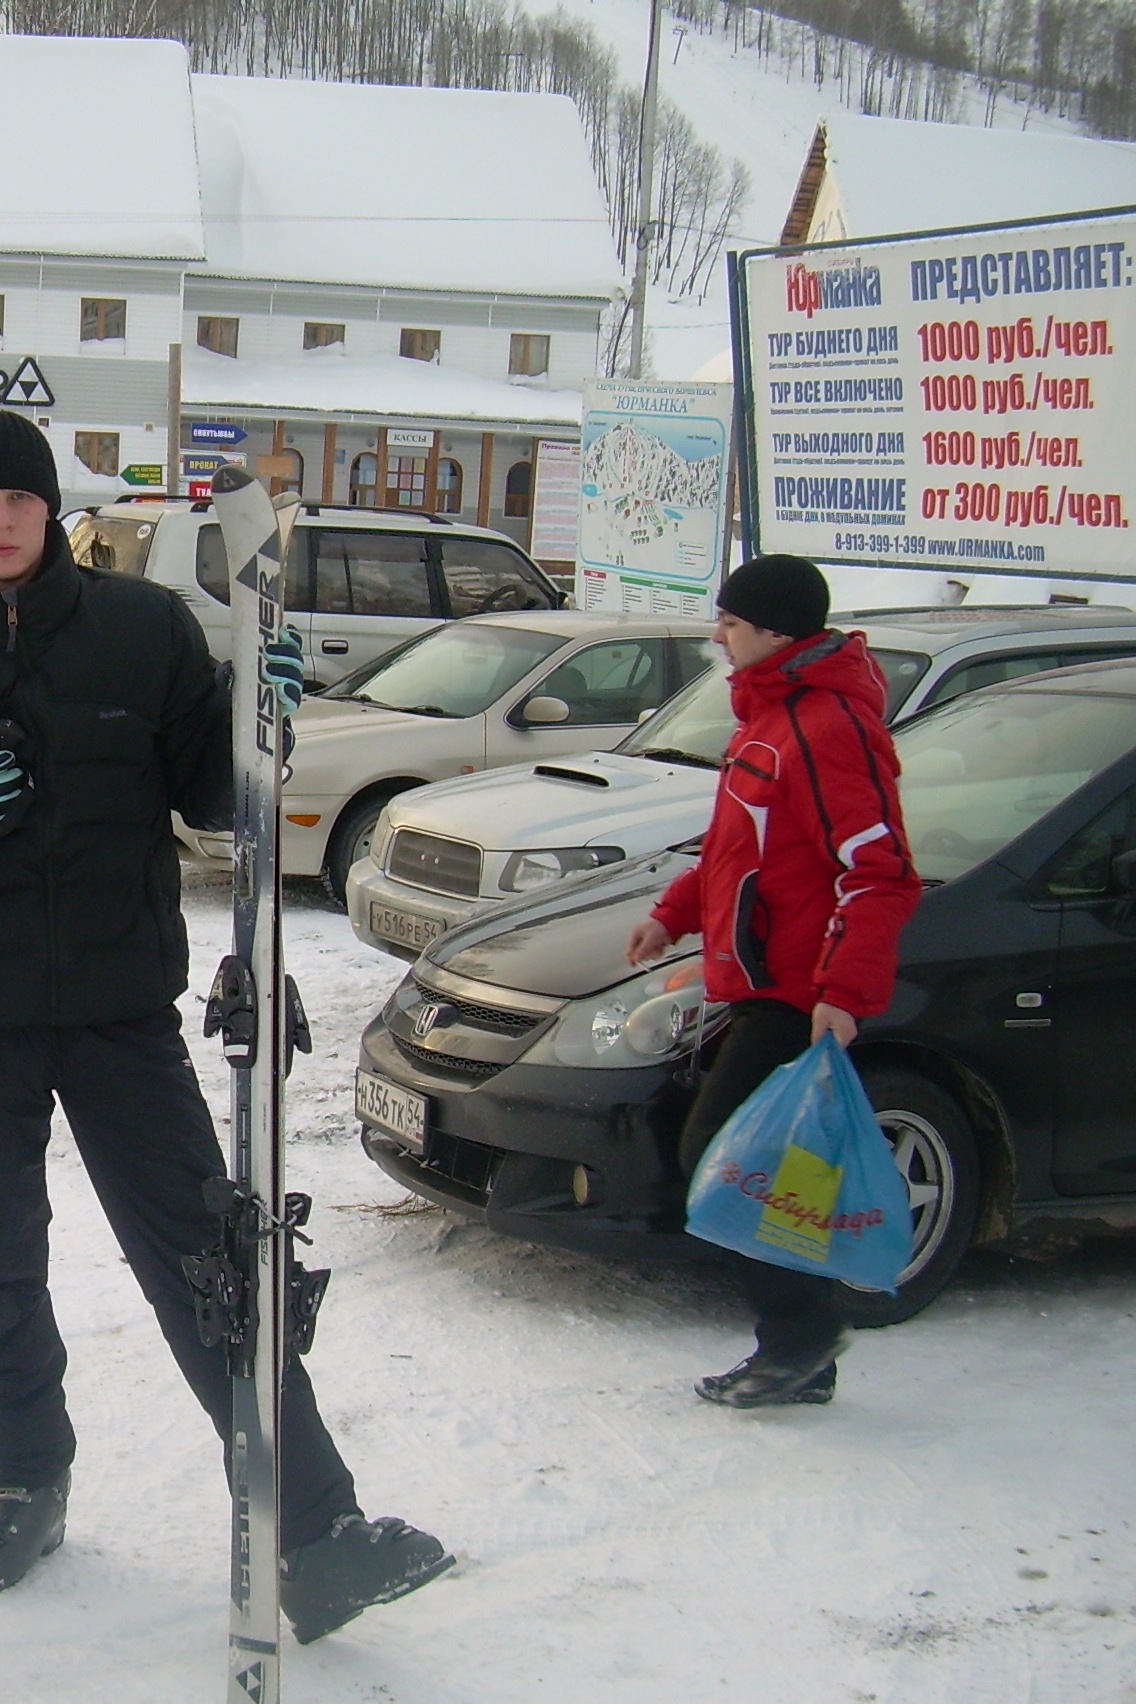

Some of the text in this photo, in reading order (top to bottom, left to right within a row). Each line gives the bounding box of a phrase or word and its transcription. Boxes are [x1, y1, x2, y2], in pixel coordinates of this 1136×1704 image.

[910, 241, 1133, 305] ПРЕДСТАВЛЯЕТ:
[768, 326, 899, 359] ТУР БУДНЕГО ДНЯ
[917, 314, 1114, 364] 1000 руб./чел.
[769, 377, 903, 404] ТУР ВСЕ ВКЛЮЧЕНО
[919, 371, 1094, 415] 1000 руб./чел.
[393, 433, 427, 443] КАССЫ
[772, 432, 905, 457] ТУР ВЫХОДНОГО ДНЯ
[922, 430, 1083, 470] 1600 руб./чел.
[189, 460, 219, 470] ПРОКАТ
[774, 476, 906, 512] ПРОЖИВАНИЕ
[921, 482, 1129, 529] от 300 руб./чел.
[835, 532, 1046, 562] 8-913-399-1-399 www.URMANKA.com
[256, 570, 276, 757] FISHER
[407, 1098, 420, 1129] 54
